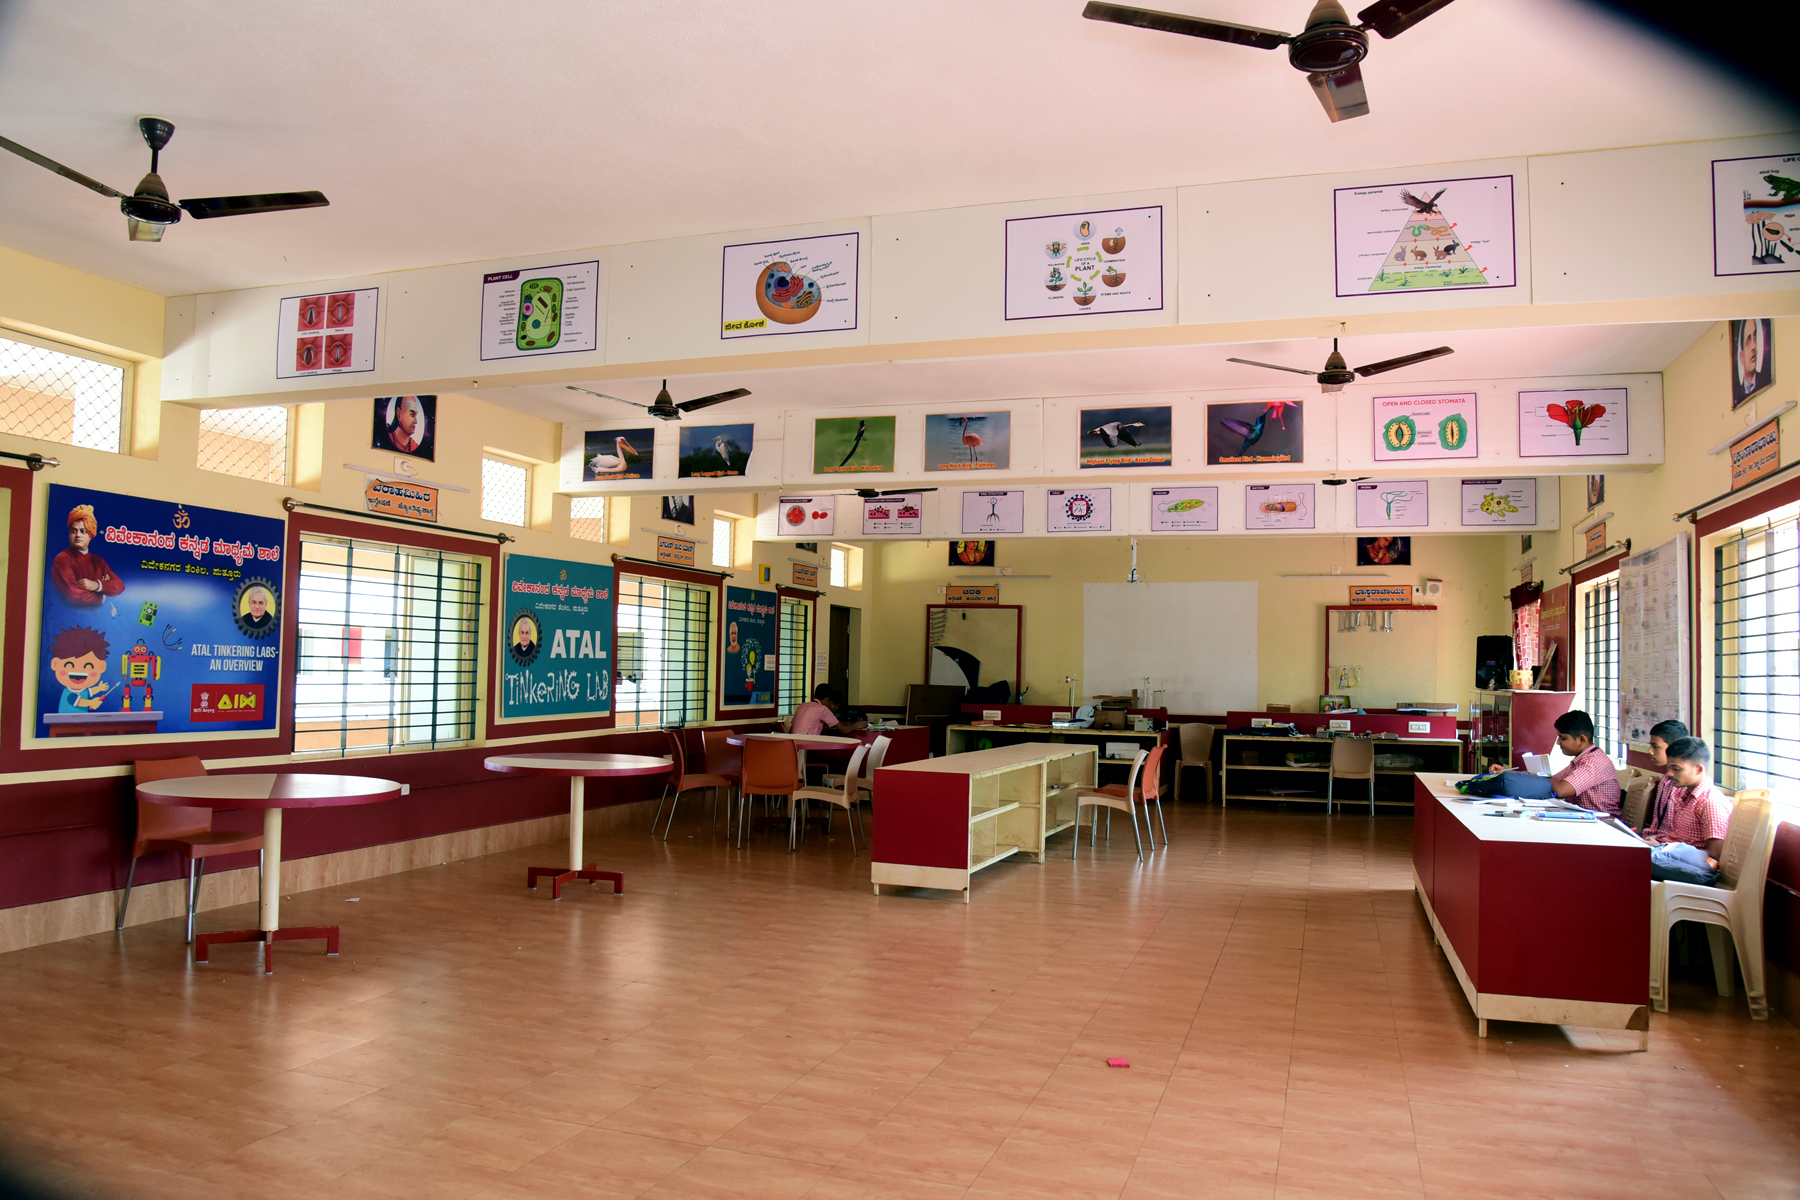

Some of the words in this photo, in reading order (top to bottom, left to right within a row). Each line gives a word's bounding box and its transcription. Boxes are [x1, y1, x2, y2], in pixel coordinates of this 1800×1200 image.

[105, 525, 175, 549] ವಿವೇಕಾನಂದ
[179, 533, 210, 560] ಕನ್ನಡ
[213, 537, 254, 566] ಮಾಧ್ಯಮ
[257, 545, 280, 561] ಶಾಲೆ
[191, 644, 211, 656] ATAL
[213, 644, 255, 657] TINKERING
[256, 646, 279, 658] LABS-
[550, 629, 607, 659] ATAL
[209, 659, 221, 671] AN
[223, 659, 264, 672] OVERVIEW
[586, 669, 609, 701] LAB
[217, 694, 256, 709] AIM
